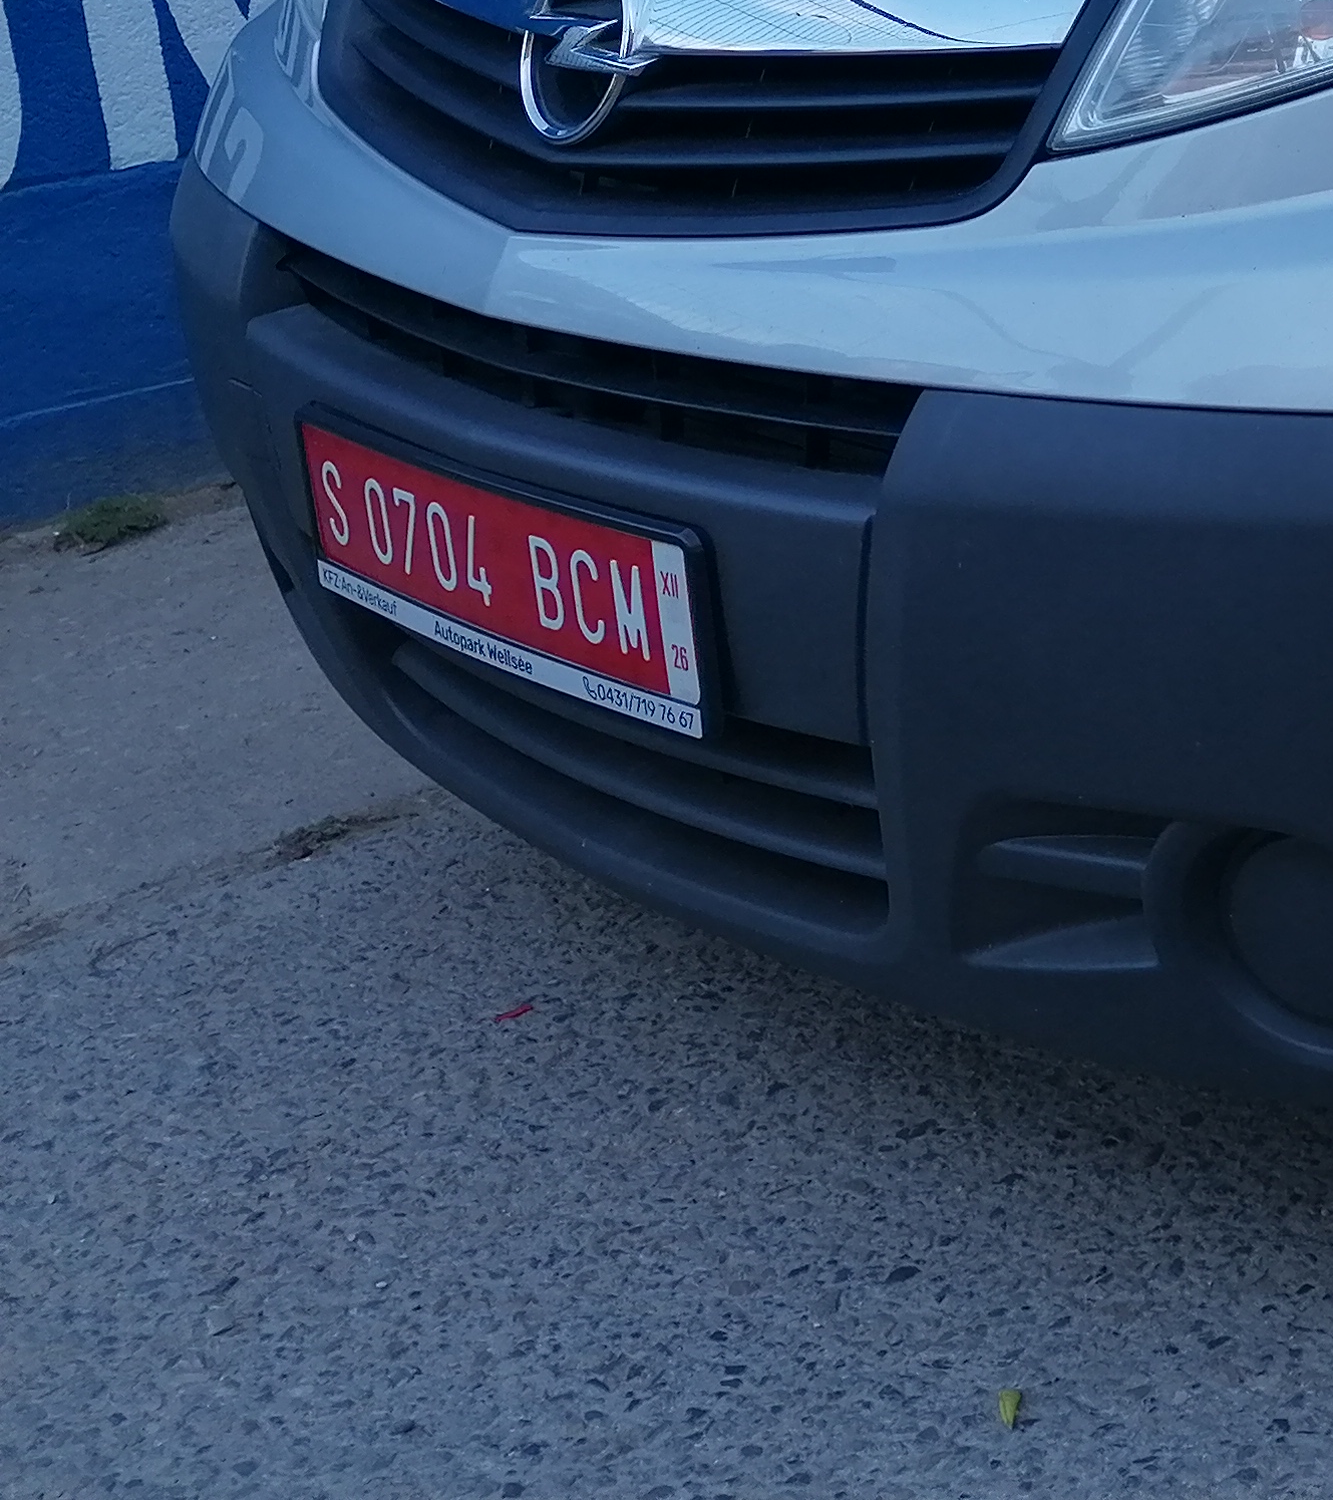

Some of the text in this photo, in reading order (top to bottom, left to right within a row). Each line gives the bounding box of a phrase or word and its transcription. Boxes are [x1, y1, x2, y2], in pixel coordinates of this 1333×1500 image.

[321, 460, 652, 662] S 0704 BCM
[434, 620, 486, 657] Autopark
[486, 642, 533, 675] Wellsee
[597, 683, 656, 717] 0431/719
[659, 703, 676, 724] 76
[679, 710, 694, 730] 67
[670, 644, 690, 672] 26
